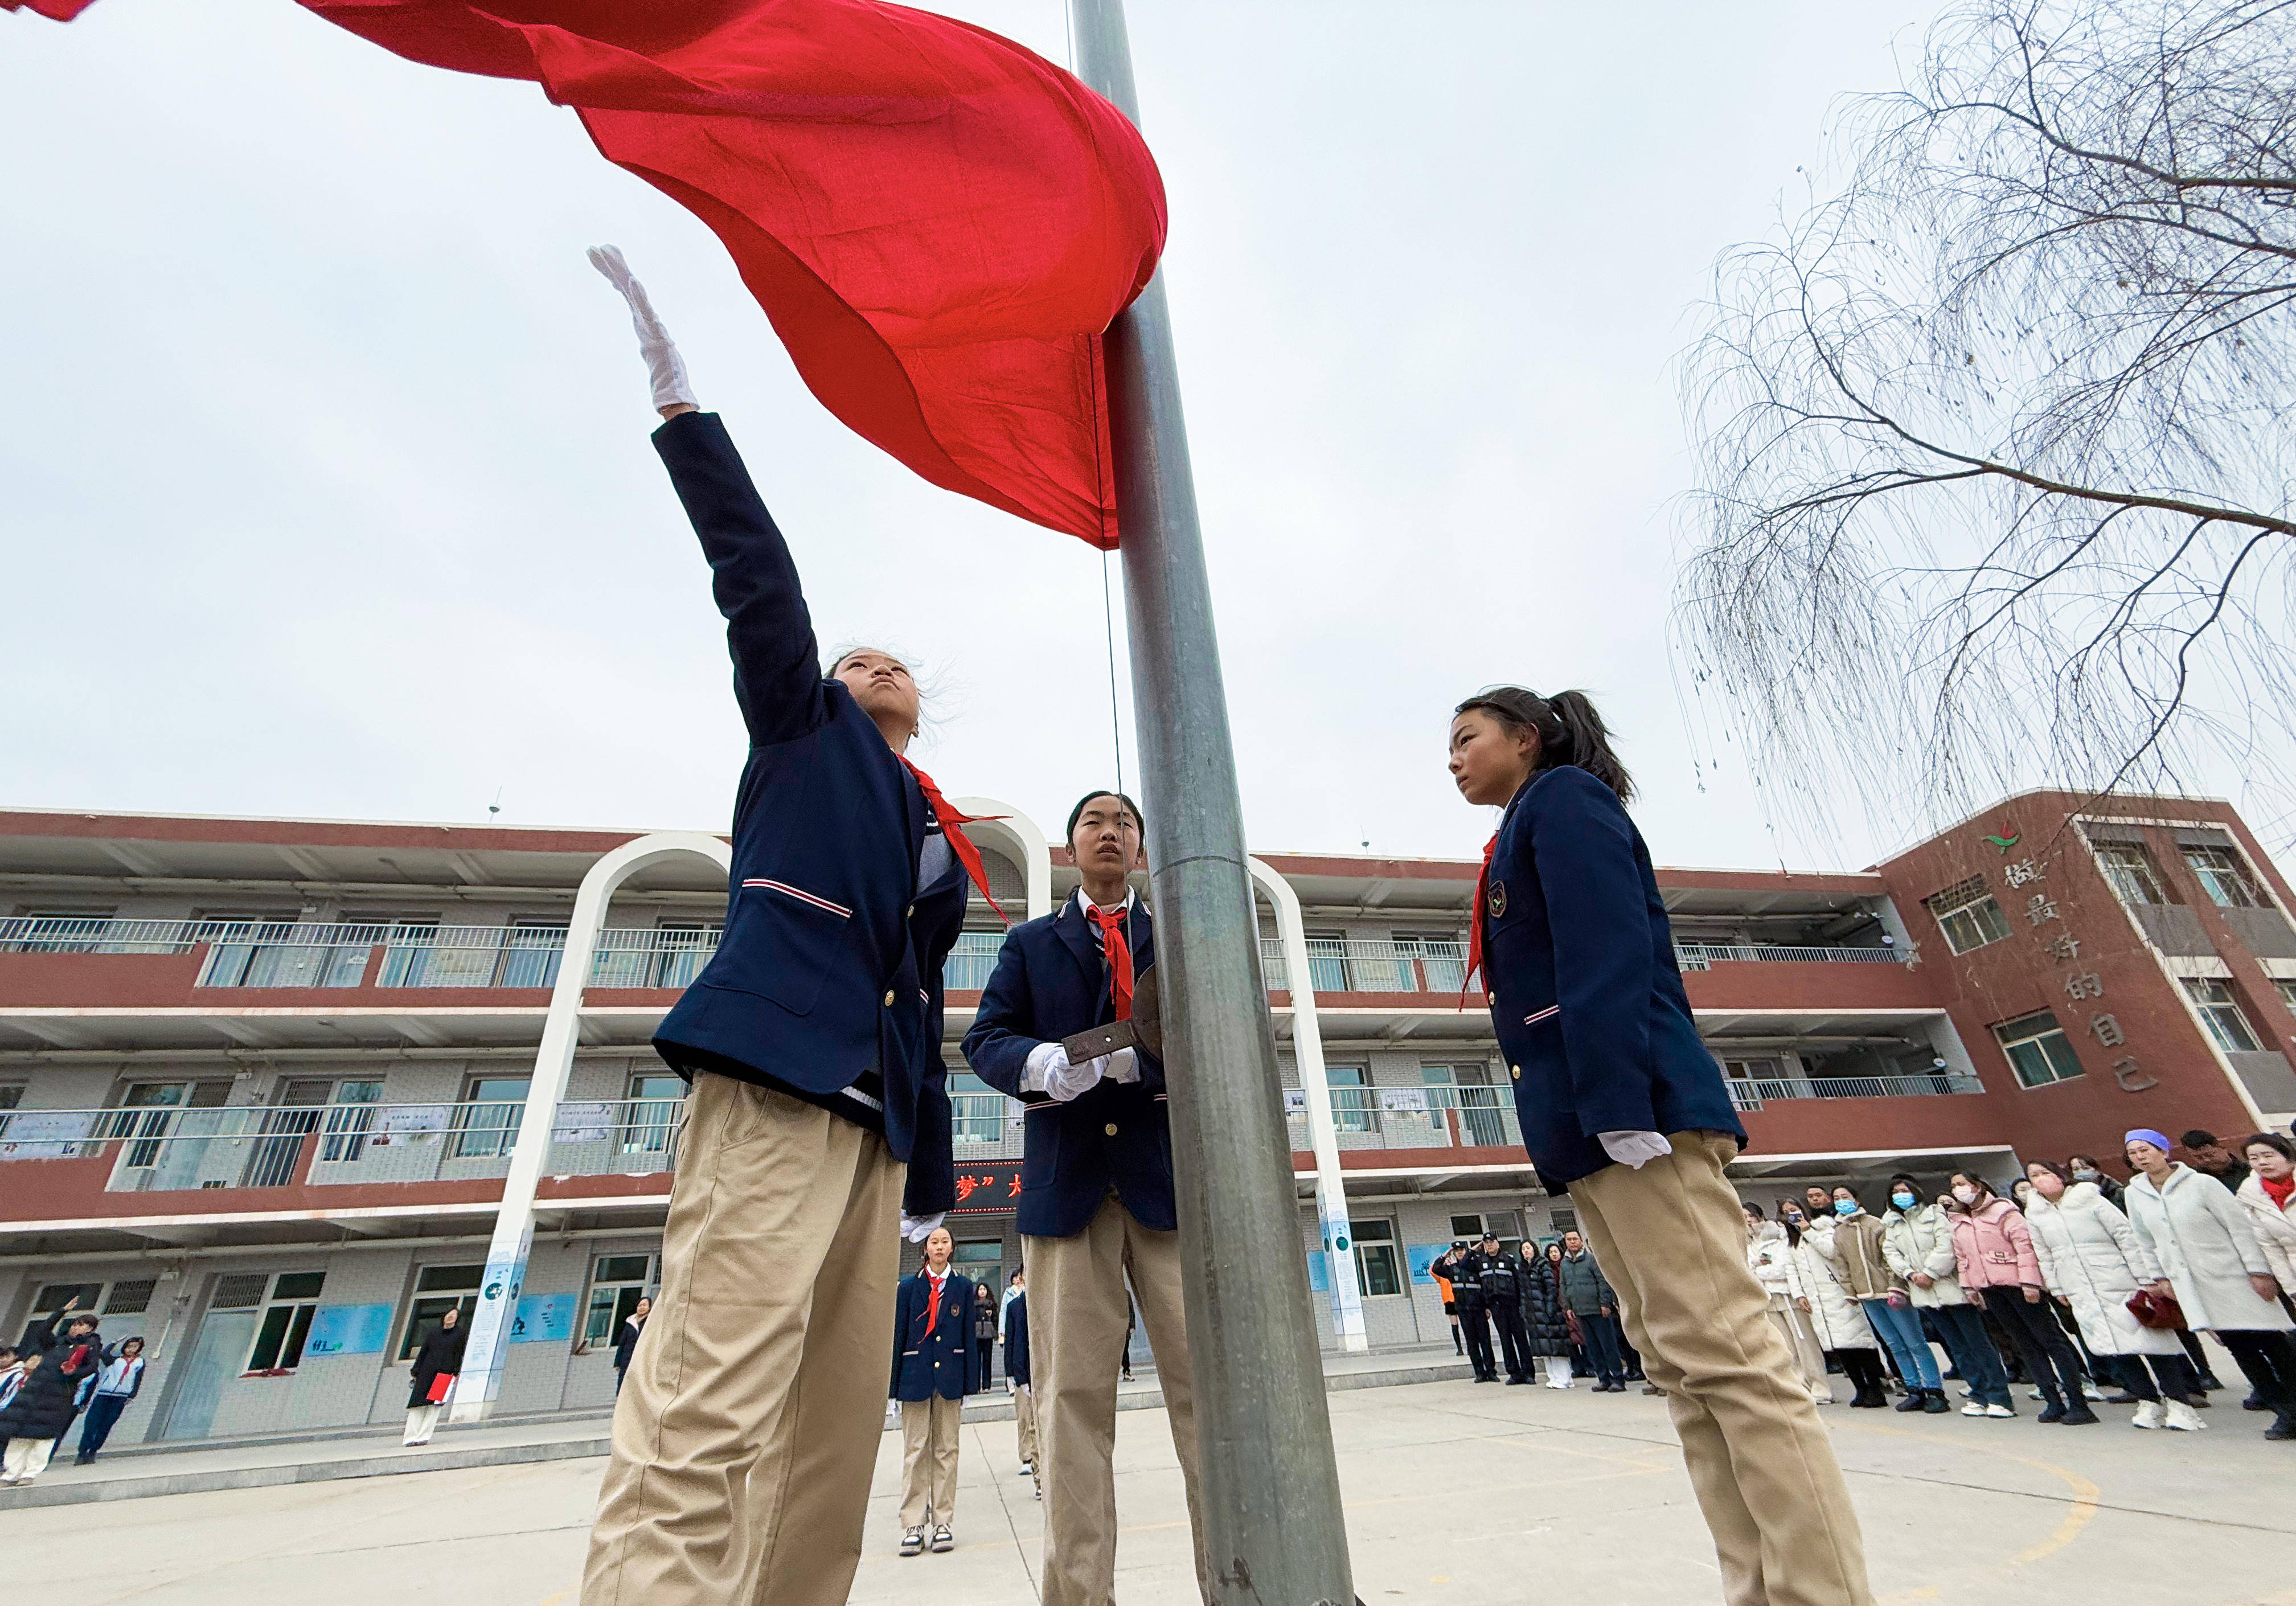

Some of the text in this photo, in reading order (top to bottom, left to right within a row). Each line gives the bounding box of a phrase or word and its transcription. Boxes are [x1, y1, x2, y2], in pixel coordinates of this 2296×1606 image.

[2004, 858, 2159, 1092] 做最好的自己
